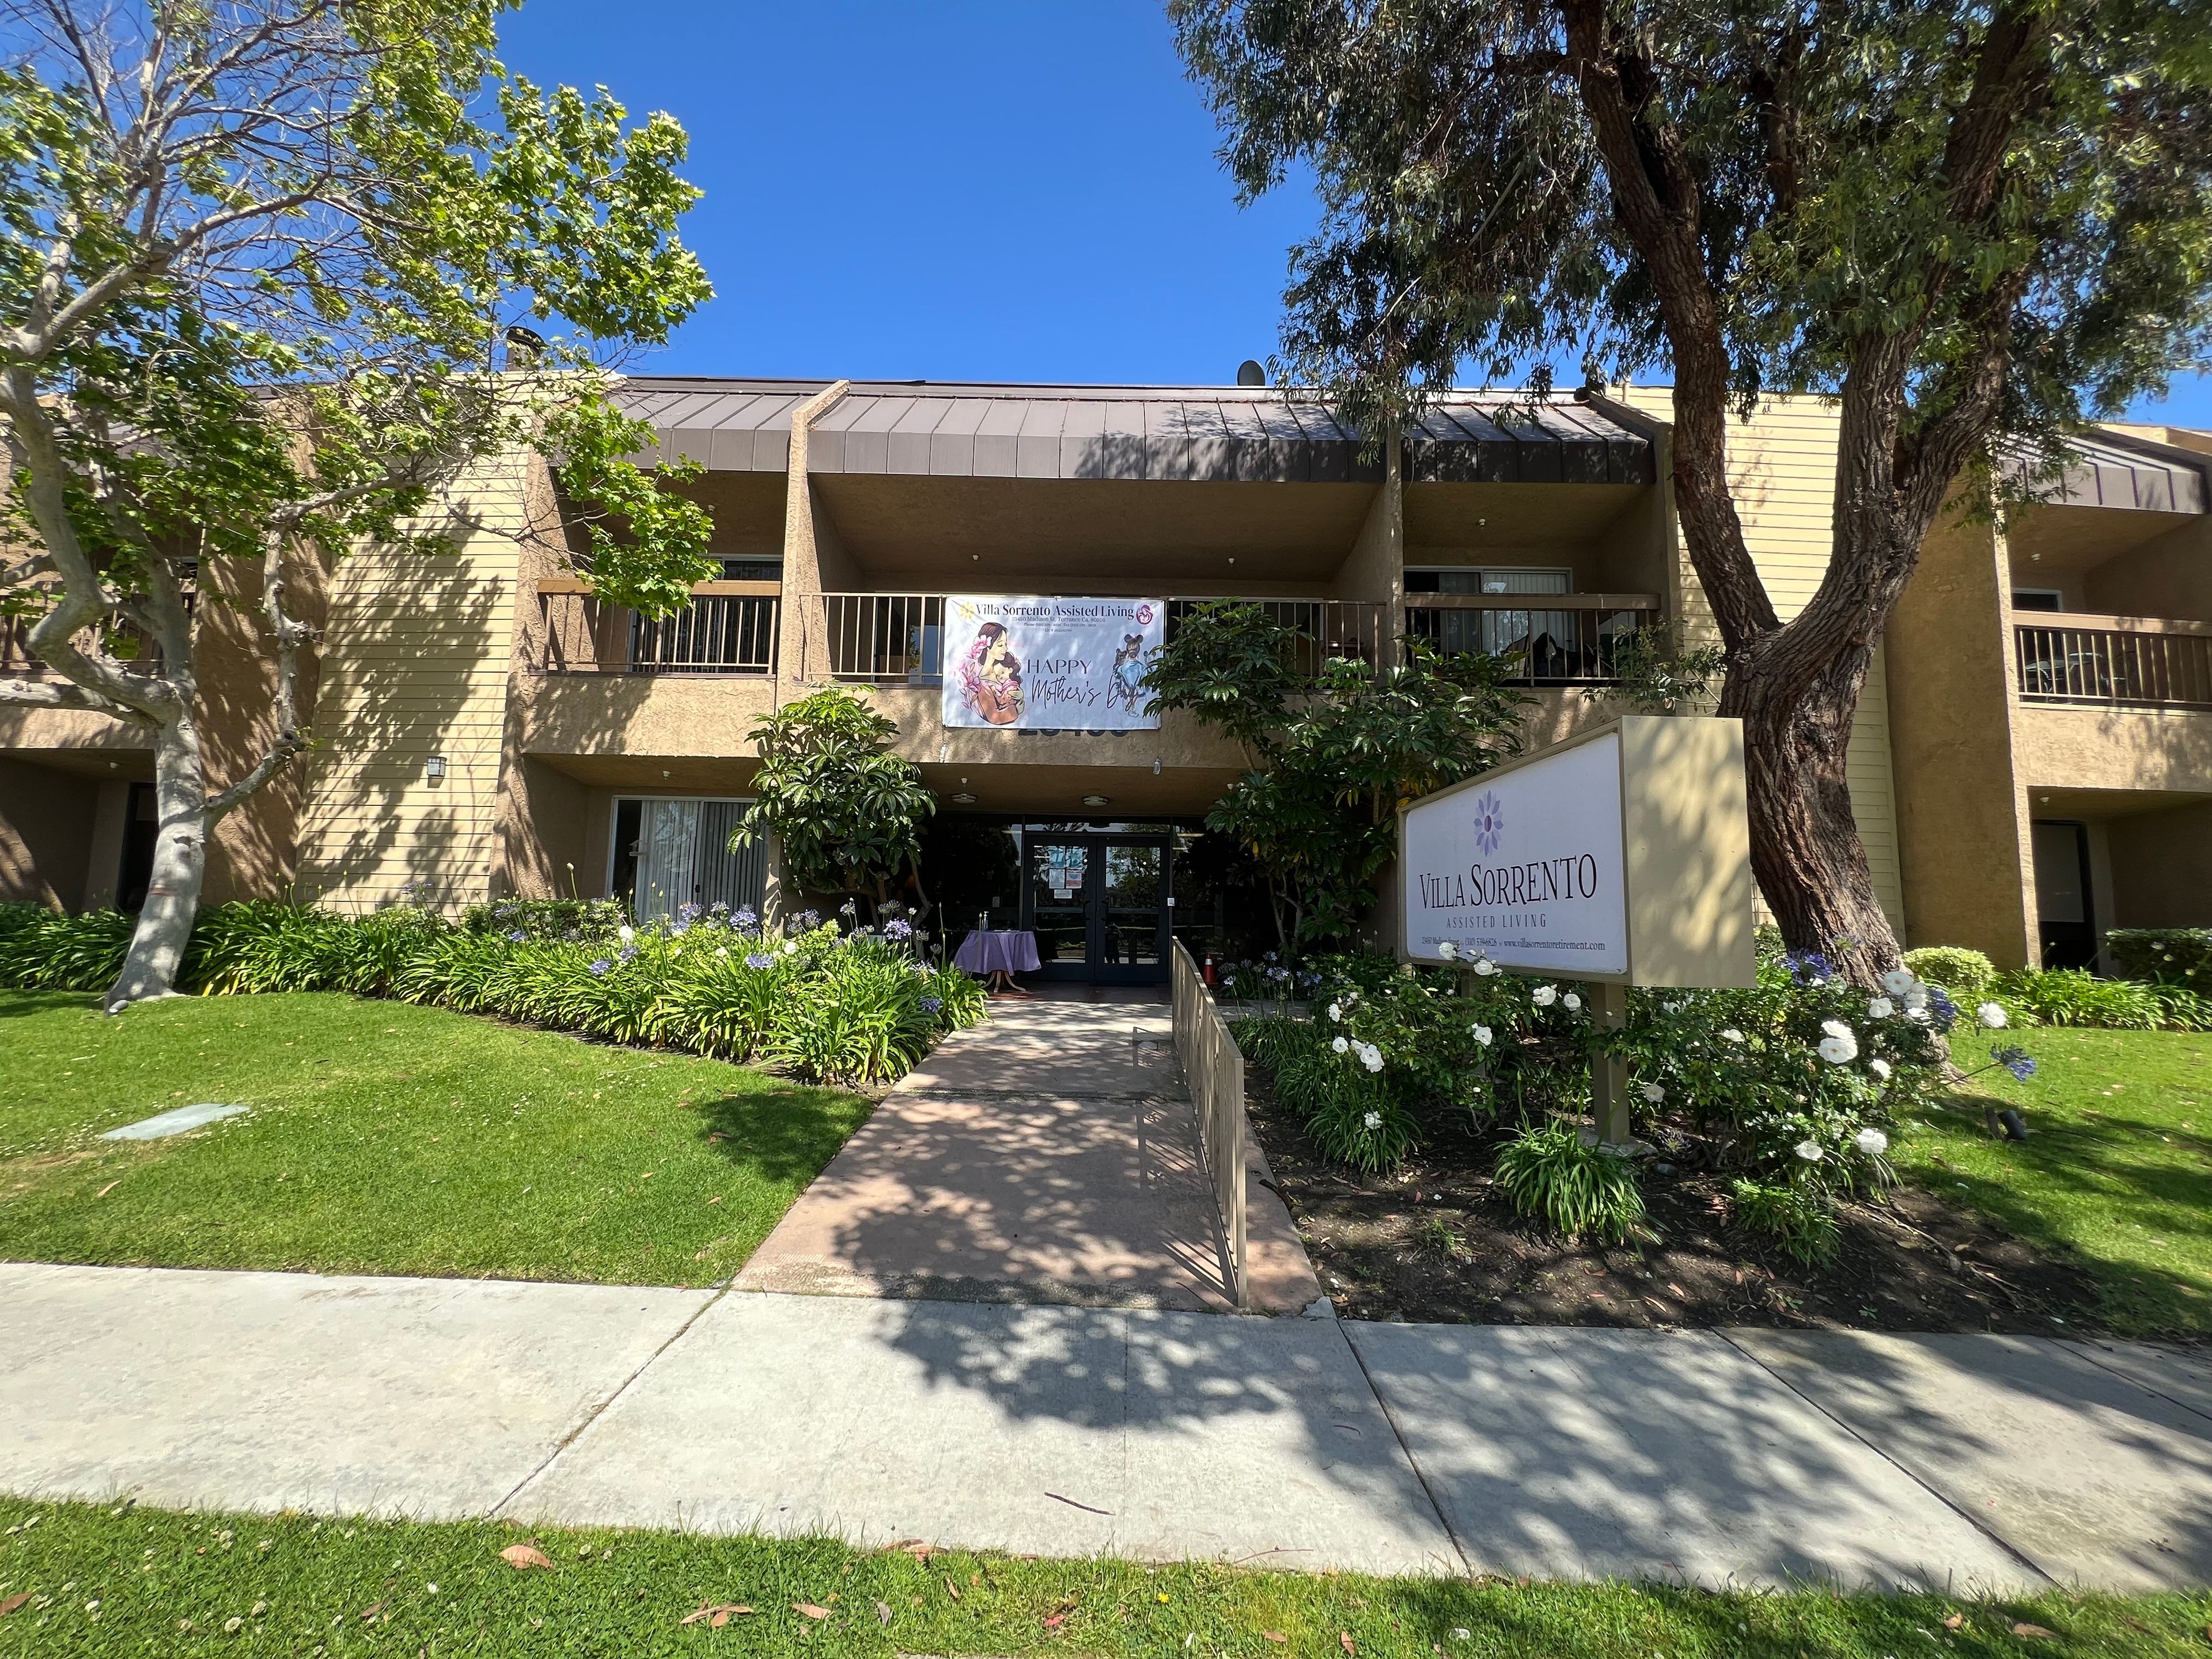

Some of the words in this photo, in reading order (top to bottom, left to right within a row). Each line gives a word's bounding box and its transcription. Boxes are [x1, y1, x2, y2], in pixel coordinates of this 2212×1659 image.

[976, 604, 1000, 615] Villa
[1002, 604, 1051, 616] Sorrento
[1053, 605, 1098, 616] Assisted
[1101, 605, 1134, 620] Living
[1027, 659, 1092, 674] HAPPY
[1032, 675, 1101, 709] Mother's
[1107, 673, 1138, 712] Day
[1419, 873, 1466, 909] VILLA
[1470, 854, 1597, 907] SORRENTO
[1446, 915, 1495, 928] ASSISTED
[1502, 913, 1547, 927] LIVING
[1503, 937, 1606, 950] www.villasorrentoretirement.com
